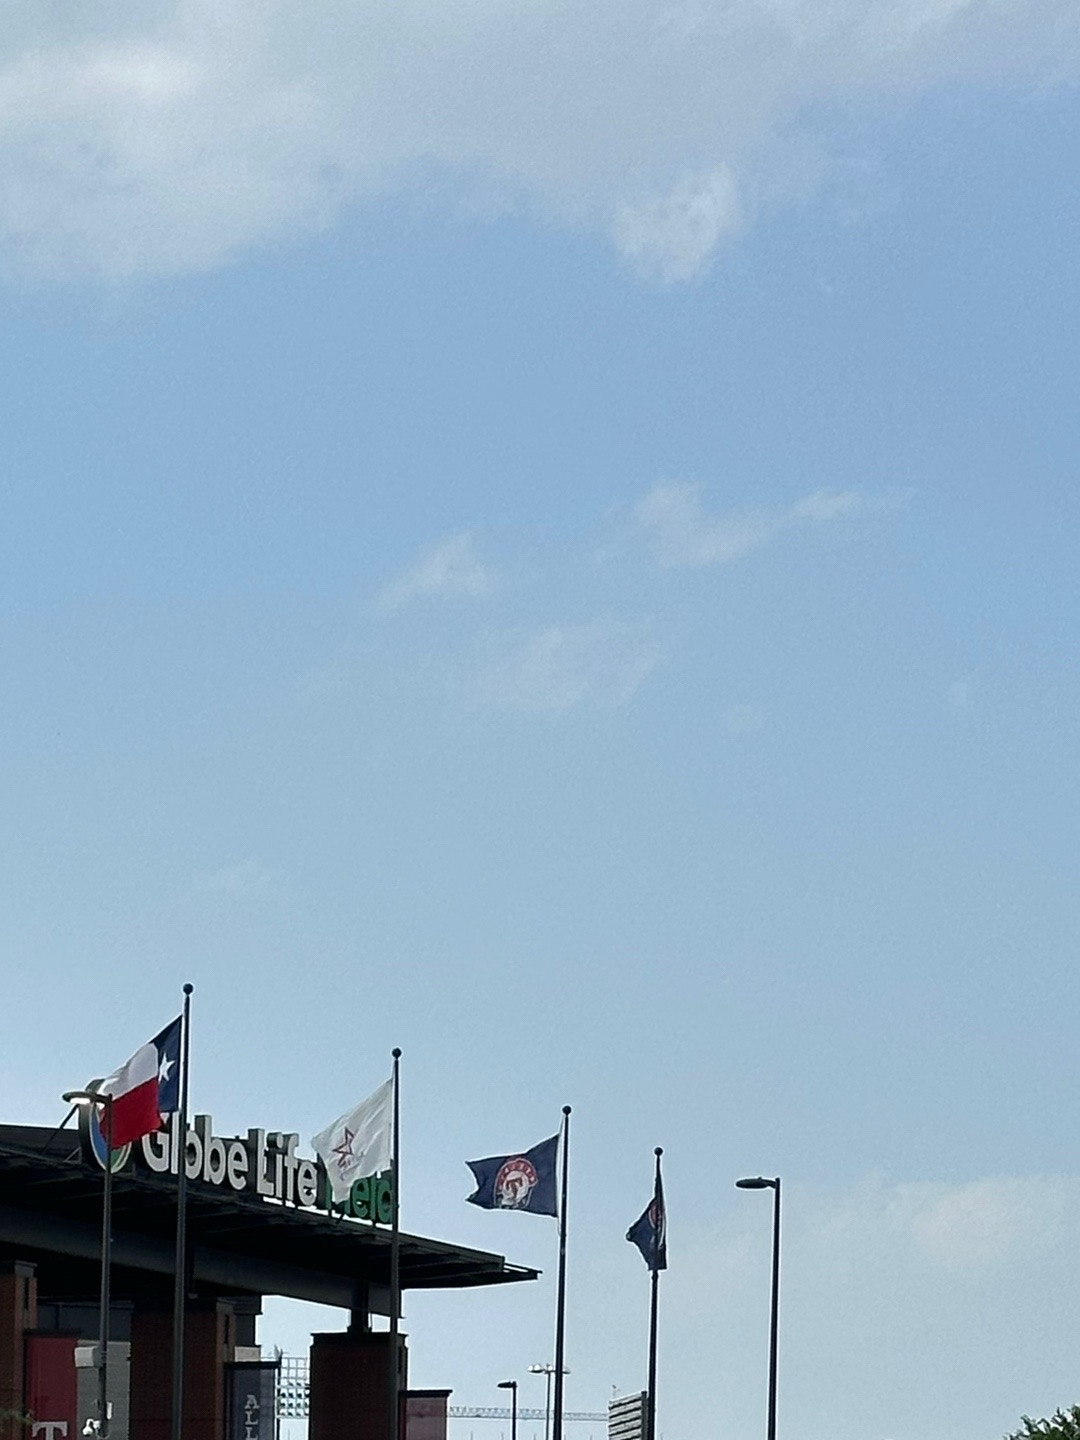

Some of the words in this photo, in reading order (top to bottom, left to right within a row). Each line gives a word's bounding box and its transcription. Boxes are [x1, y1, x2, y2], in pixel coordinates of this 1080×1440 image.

[141, 1111, 249, 1190] Globe
[251, 1128, 318, 1207] Life
[244, 1394, 259, 1440] ALL
